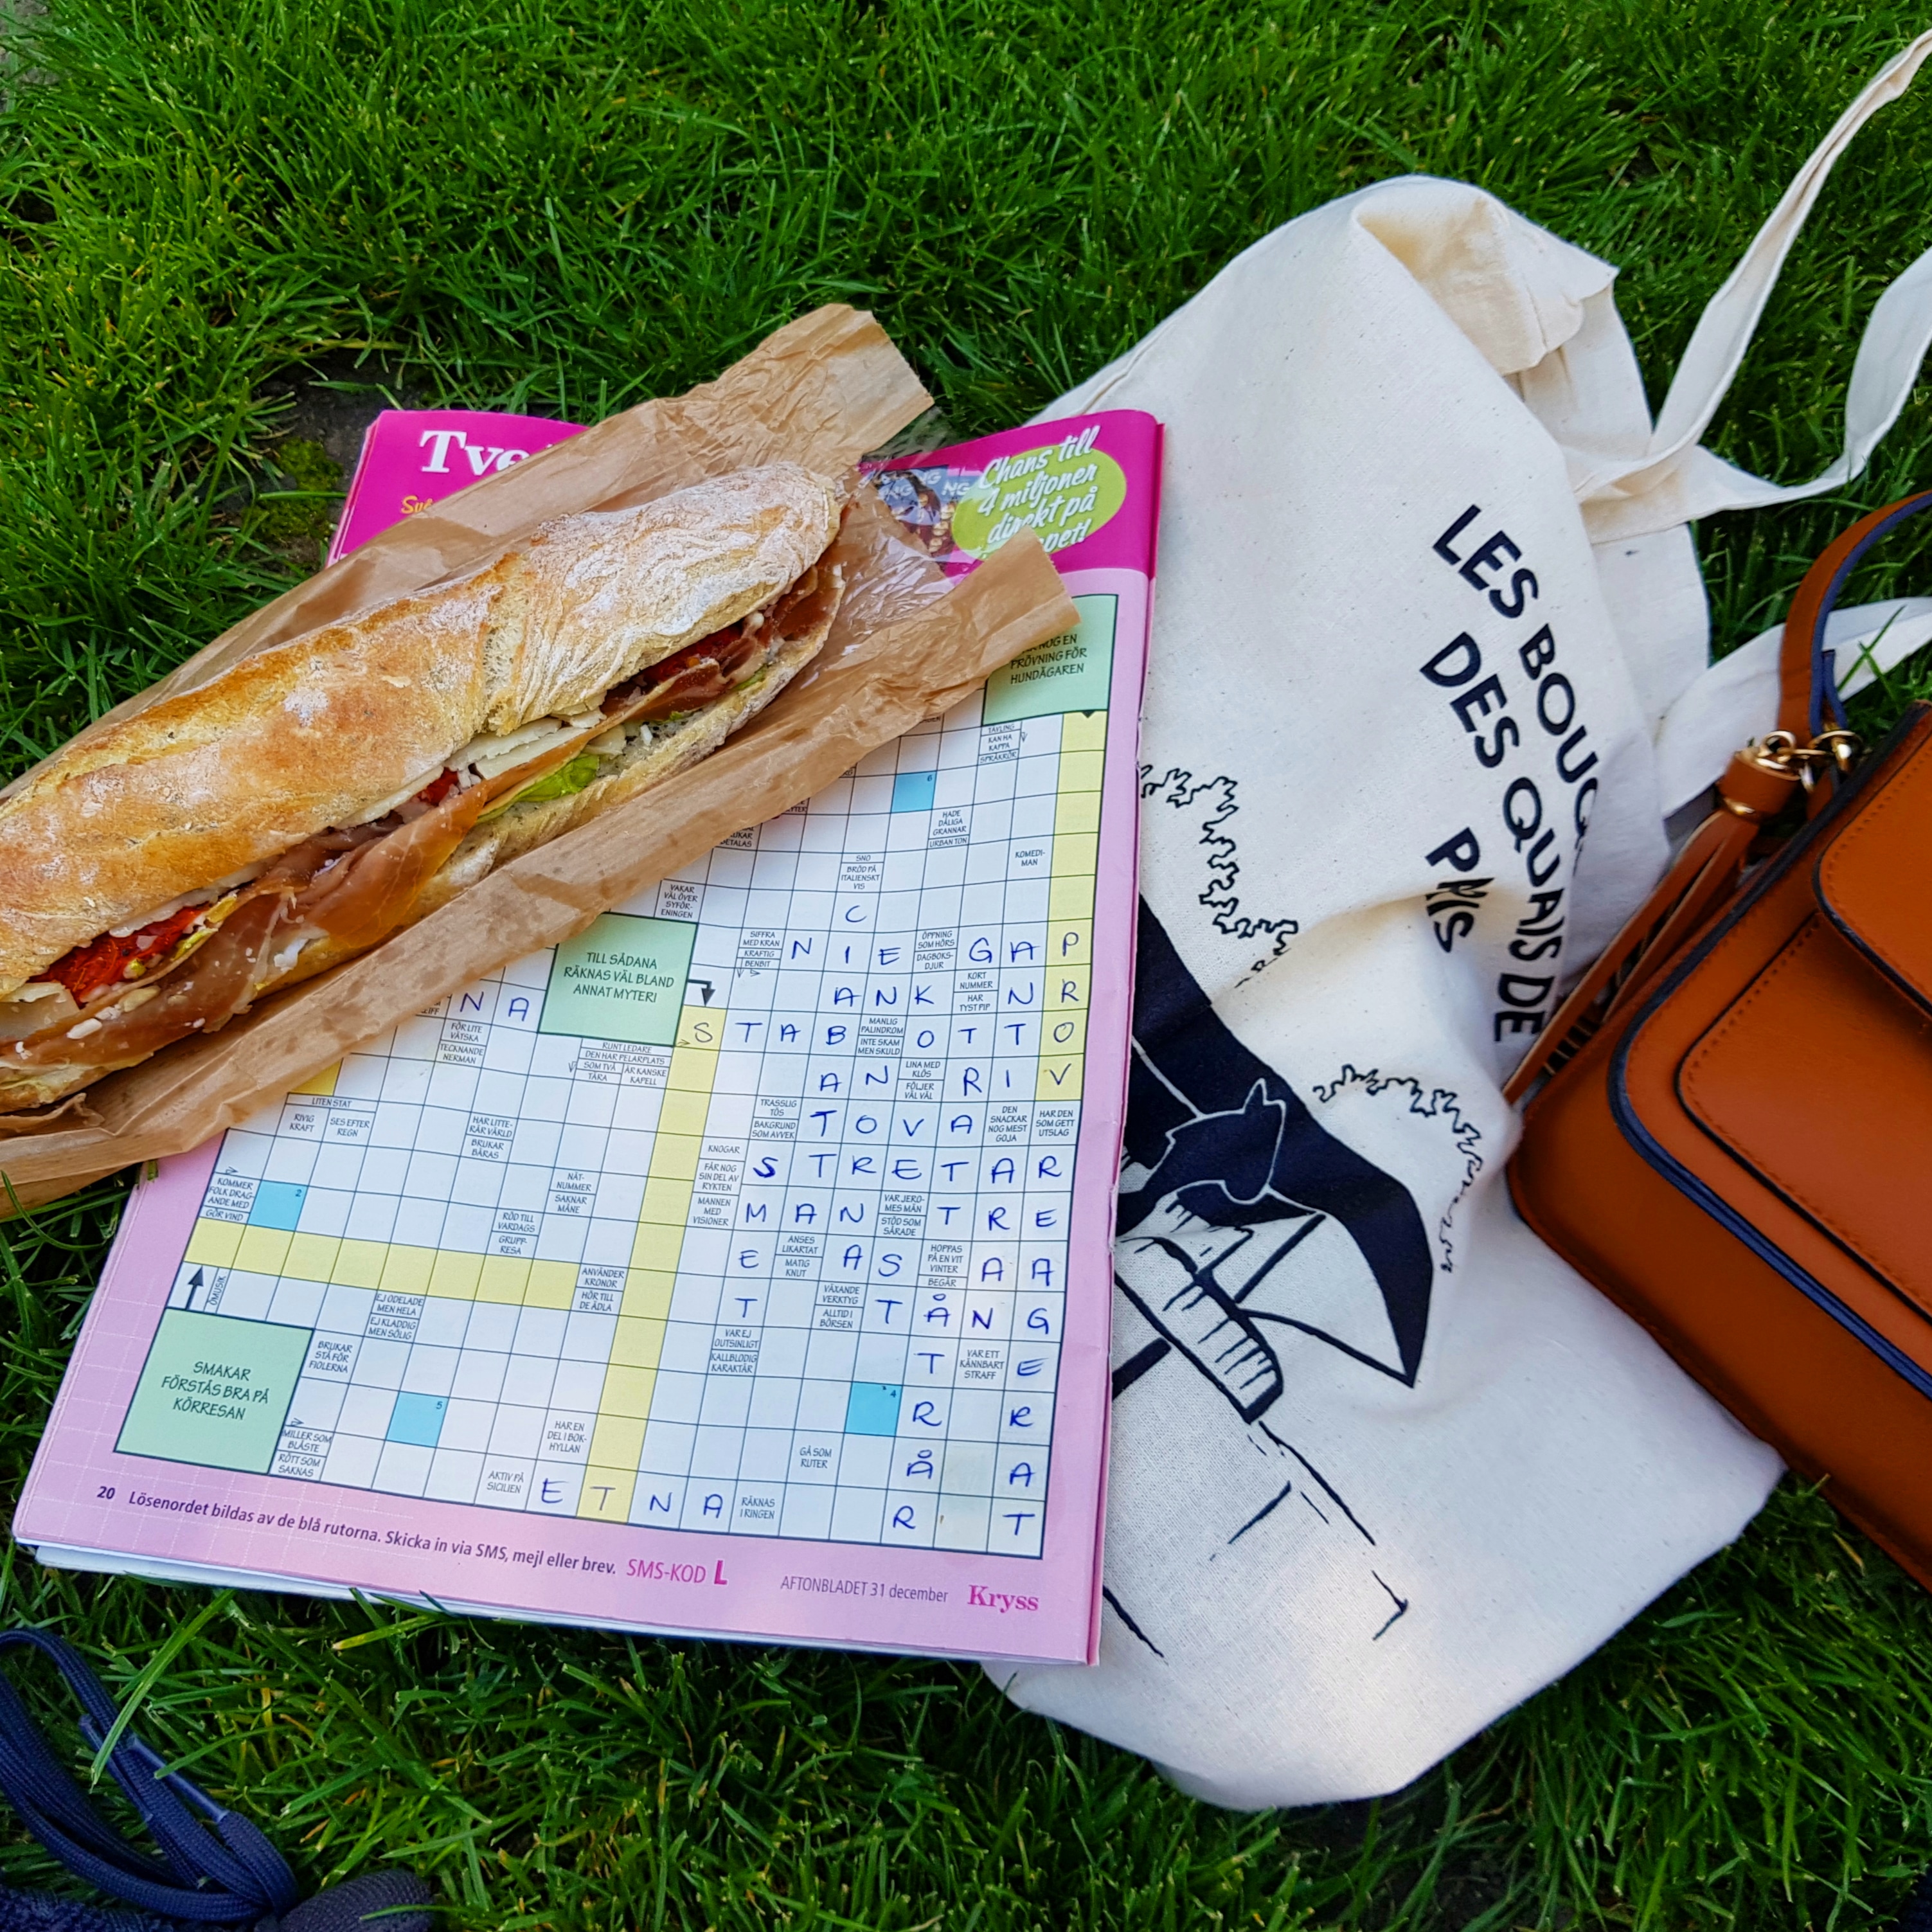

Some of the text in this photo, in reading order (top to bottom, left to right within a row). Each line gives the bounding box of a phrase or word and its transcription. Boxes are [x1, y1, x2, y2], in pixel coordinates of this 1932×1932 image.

[979, 449, 1053, 489] Chans
[1059, 425, 1100, 463] till
[978, 463, 1098, 515] 4 miljoner
[1059, 486, 1098, 527] på
[1432, 504, 1539, 618] LES
[1064, 634, 1078, 644] EN
[1065, 647, 1087, 660] FÖR
[933, 826, 967, 836] GRANNAR
[1419, 631, 1520, 768] DES
[1493, 972, 1555, 1042] DE
[929, 839, 953, 848] URBAN
[1015, 849, 1045, 858] KOMEDI-
[841, 873, 880, 882] ITALIENSKT
[670, 884, 695, 893] VAKAR
[661, 909, 693, 918] ENINGEN
[587, 952, 657, 970] TILL SÅDANA
[564, 965, 674, 988] RÄKNAS VÄL BLAND
[960, 981, 993, 989] NUMMER
[573, 984, 657, 1003] ANNAT MYTERI
[861, 1026, 904, 1034] PALINDROM
[440, 1043, 483, 1056] TECKNANDE
[602, 1042, 652, 1053] RUNT LEDARE
[443, 1054, 476, 1064] NERMAN
[636, 1067, 666, 1077] KANSKE
[630, 1076, 657, 1086] KAPELL
[312, 1097, 352, 1107] LITEN STAT
[760, 1099, 797, 1107] TRASSLIG
[294, 1113, 315, 1123] RIVIG
[290, 1123, 315, 1132] KRAFT
[346, 1118, 370, 1129] EFTER
[754, 1121, 796, 1130] BAKGRUND
[337, 1127, 358, 1137] REGN
[771, 1131, 795, 1139] AVVEK
[471, 1138, 505, 1150] BRUKAR
[708, 1145, 740, 1154] KNOGAR
[217, 1177, 253, 1190] KOMMER
[556, 1182, 592, 1191] NUMMER
[702, 1183, 732, 1192] RYKTEN
[209, 1186, 229, 1195] FOLK
[208, 1196, 231, 1206] ANDE
[555, 1194, 587, 1204] SAKNAR
[697, 1197, 731, 1206] MANNEN
[692, 1217, 729, 1226] VISIONER
[498, 1222, 535, 1232] VARDAGS
[500, 1245, 521, 1255] RESA
[782, 1245, 818, 1255] LIKARTAT
[785, 1259, 810, 1267] MATIG
[785, 1269, 807, 1277] KNUT
[930, 1265, 958, 1273] VINTER
[584, 1278, 618, 1288] KRONOR
[822, 1296, 859, 1305] VERKTYG
[377, 1304, 416, 1316] MEN HELA
[823, 1309, 849, 1318] ALLTID
[382, 1319, 416, 1330] KLADDIG
[318, 1341, 353, 1353] BRUKAR
[714, 1339, 759, 1349] OUTSINLIGT
[710, 1353, 757, 1363] KALLBLODIG
[193, 1361, 251, 1381] SMAKAR
[309, 1361, 348, 1373] FIOLERNA
[964, 1370, 996, 1379] STRAFF
[161, 1374, 269, 1404] FÖRSTÅS BRA PÅ
[173, 1396, 246, 1420] KÖRRESAN
[549, 1442, 581, 1453] HYLLAN
[301, 1456, 321, 1467] SOM
[800, 1459, 828, 1469] RUTER
[278, 1465, 314, 1477] SAKNAS
[488, 1471, 514, 1481] AKTIV
[487, 1482, 521, 1494] SICILIEN
[744, 1509, 775, 1519] RINGEN
[96, 1485, 1039, 1613] 20 Lösenordet bildas av de blå rutorna. Skicka in via SMS, mejl eller brev. SMS-KOD L AFTONBLADET 31 december Kryss
